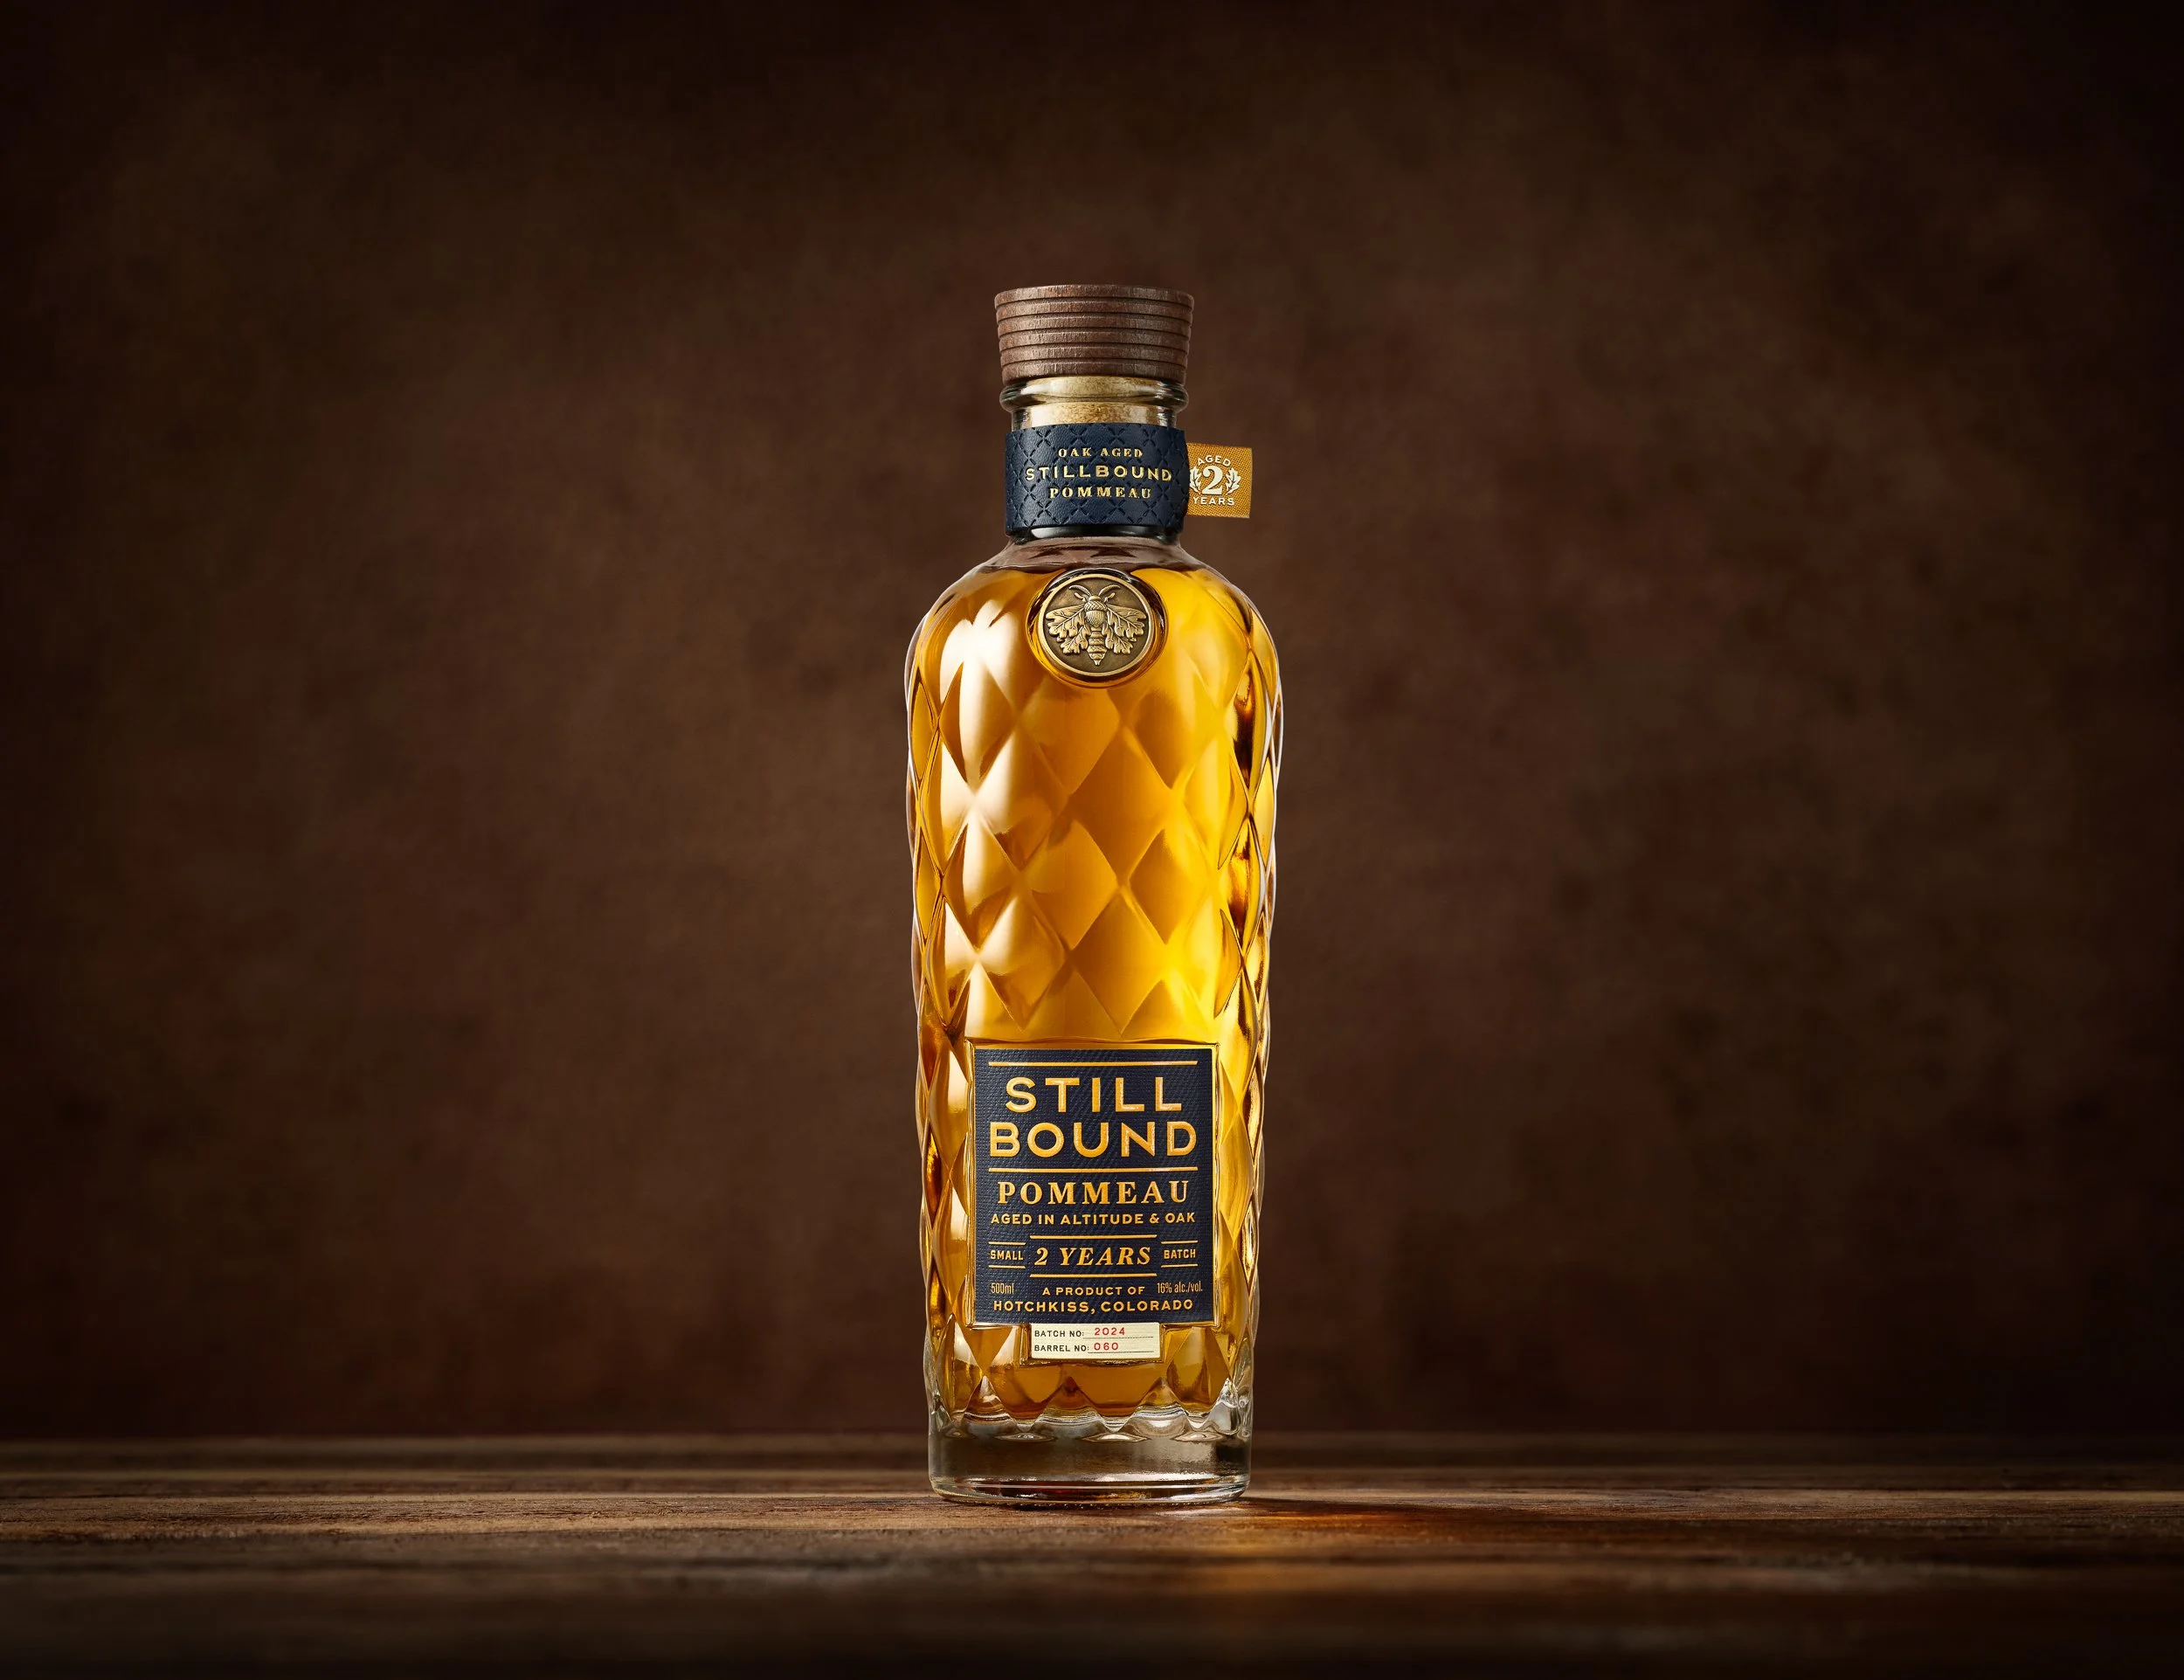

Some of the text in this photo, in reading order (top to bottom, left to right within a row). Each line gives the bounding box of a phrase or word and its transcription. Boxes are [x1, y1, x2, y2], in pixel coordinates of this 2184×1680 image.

[1058, 447, 1144, 458] OAK AGED
[1198, 454, 1231, 467] AGED
[1025, 465, 1172, 481] STILLBOUND
[1202, 465, 1223, 495] 2
[1049, 487, 1151, 499] POMMEAU
[1193, 496, 1234, 506] YEARS
[1006, 1076, 1182, 1113] STILL
[990, 1121, 1197, 1158] BOUND
[998, 1180, 1188, 1205] POMMEAU
[991, 1212, 1196, 1225] AGED IN ALTITUDE & OAK
[990, 1249, 1024, 1261] SMALL
[1034, 1247, 1151, 1266] 2 YEARS
[1164, 1248, 1196, 1260] BATCH
[991, 1282, 1014, 1295] 500ml
[1041, 1286, 1145, 1296] A PRODUCT OF
[1157, 1282, 1172, 1294] 16%
[993, 1299, 1193, 1315] HOTCHKISS, COLORADO
[1094, 1327, 1125, 1336] 2024
[1094, 1342, 1119, 1351] 060
